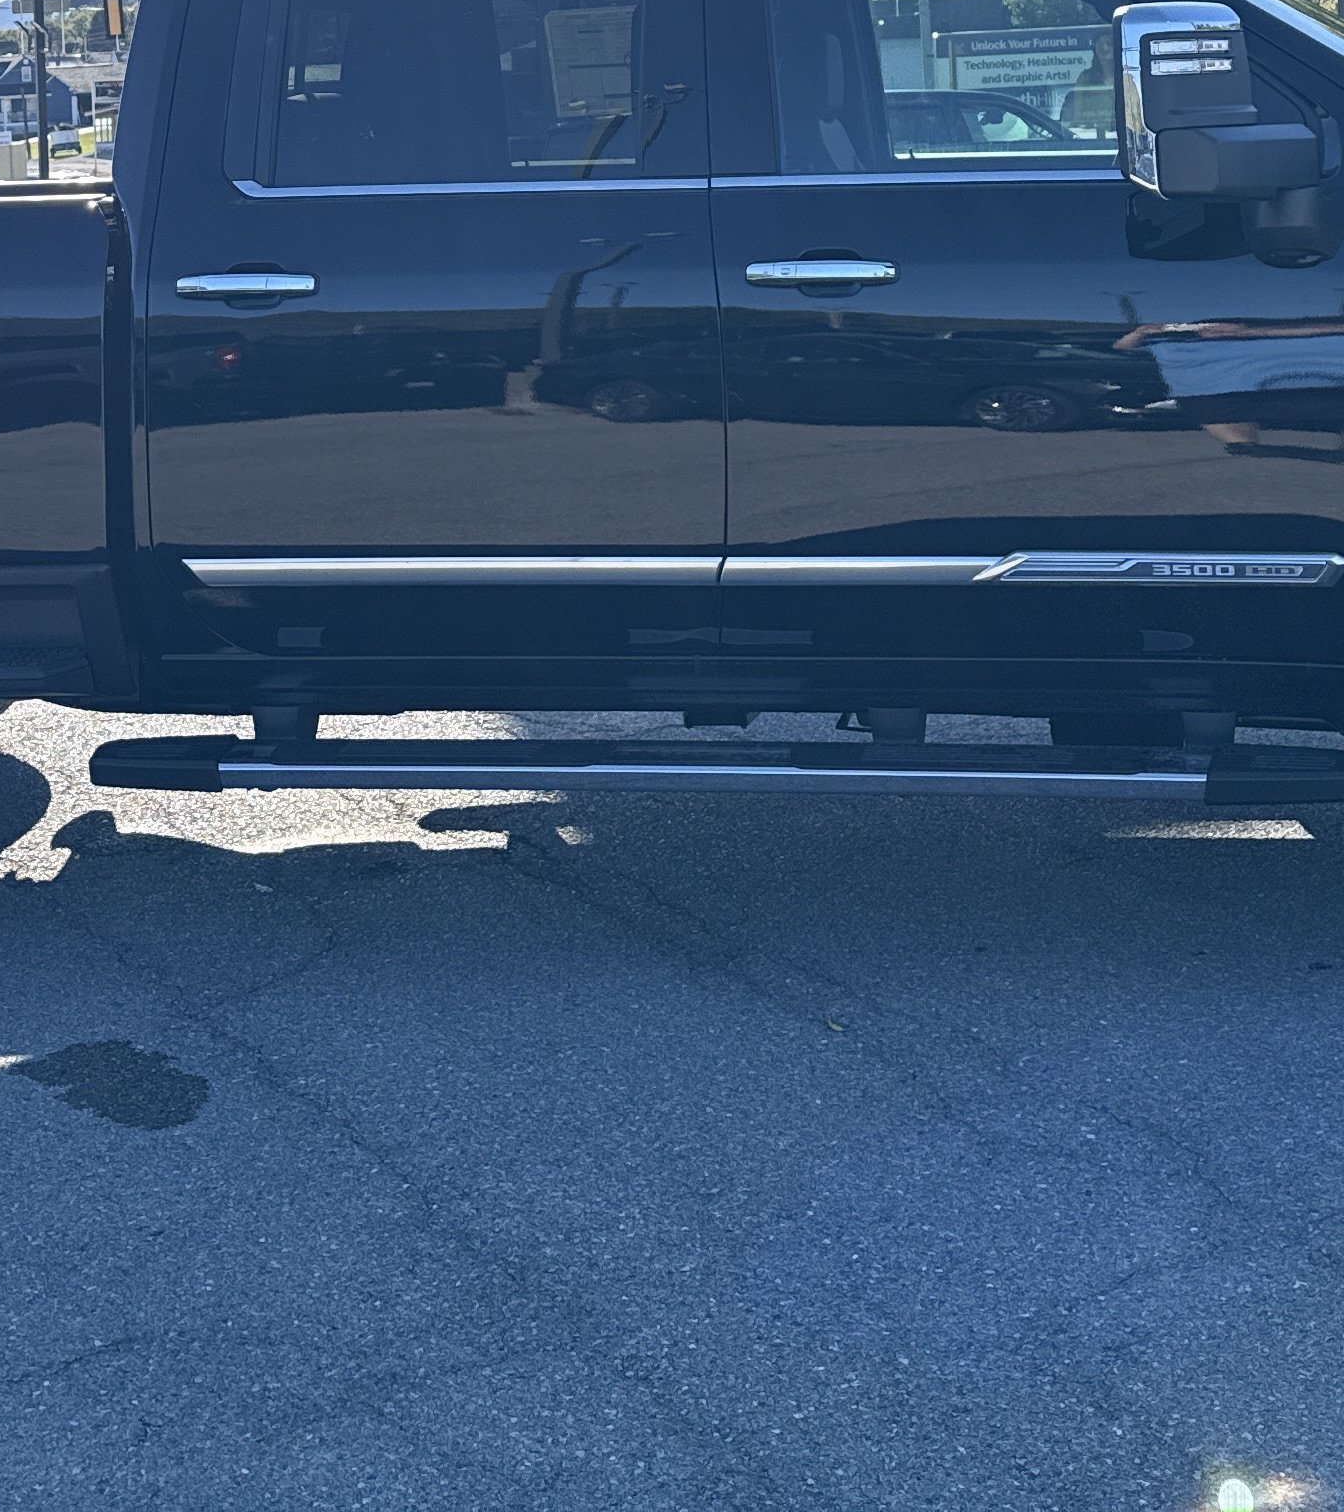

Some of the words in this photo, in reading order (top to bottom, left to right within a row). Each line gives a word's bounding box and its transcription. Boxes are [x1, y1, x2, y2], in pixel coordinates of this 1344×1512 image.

[971, 40, 1006, 51] Unlock
[1008, 38, 1032, 49] Your
[1033, 37, 1066, 48] Future
[964, 59, 1025, 71] Technology,
[1027, 54, 1087, 67] Healthcare,
[982, 73, 1001, 84] and
[1003, 71, 1044, 84] Graphic
[1046, 70, 1071, 81] Arts!
[1152, 564, 1235, 576] 3500
